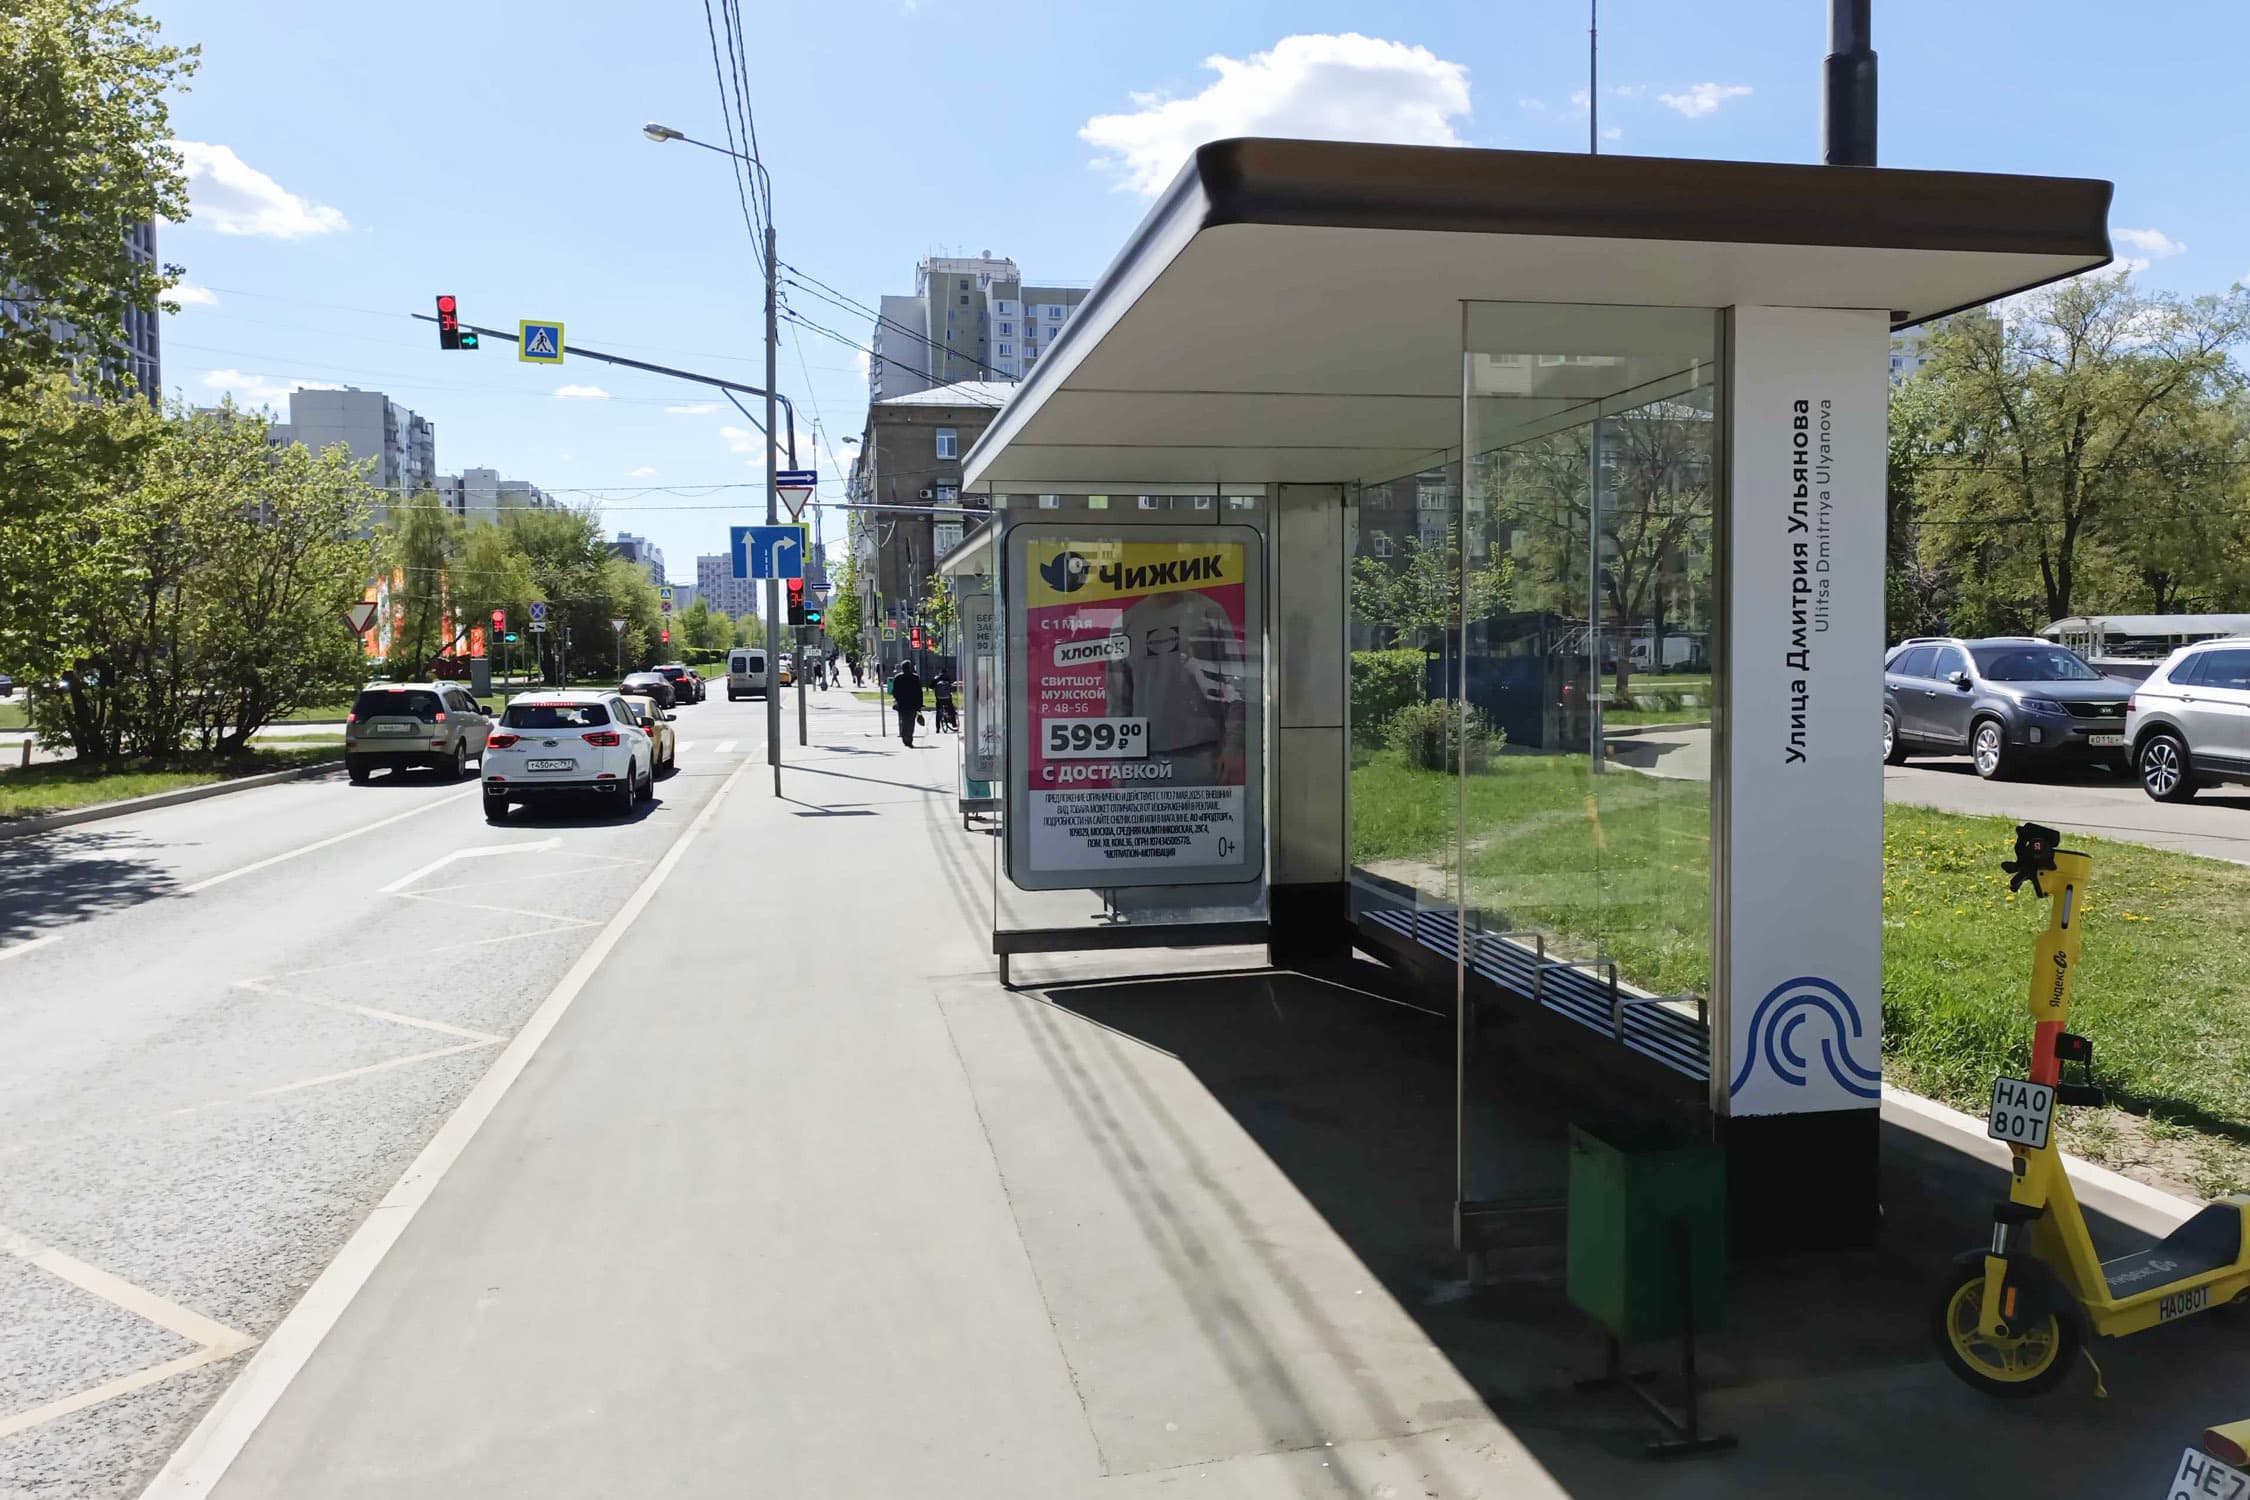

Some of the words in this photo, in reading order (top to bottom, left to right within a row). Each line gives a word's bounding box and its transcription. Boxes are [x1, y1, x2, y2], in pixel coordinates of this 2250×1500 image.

[1815, 399, 1834, 484] Ulyanova
[1788, 399, 1810, 534] Ульянова
[1815, 491, 1833, 573] Dmitriya
[1786, 541, 1812, 671] Дмитрия
[1815, 579, 1830, 632] Ulitsa
[1041, 676, 1102, 686] СВИТШОТ
[1041, 687, 1106, 700] МУЖСКОЙ
[1054, 703, 1089, 713] 48-56
[1785, 679, 1810, 764] Улица
[1051, 724, 1115, 752] 599
[1042, 766, 1056, 781] С
[1058, 760, 1173, 783] ДОСТАВКОЙ
[1218, 837, 1236, 857] 0+
[2049, 968, 2066, 1008] Яндекс
